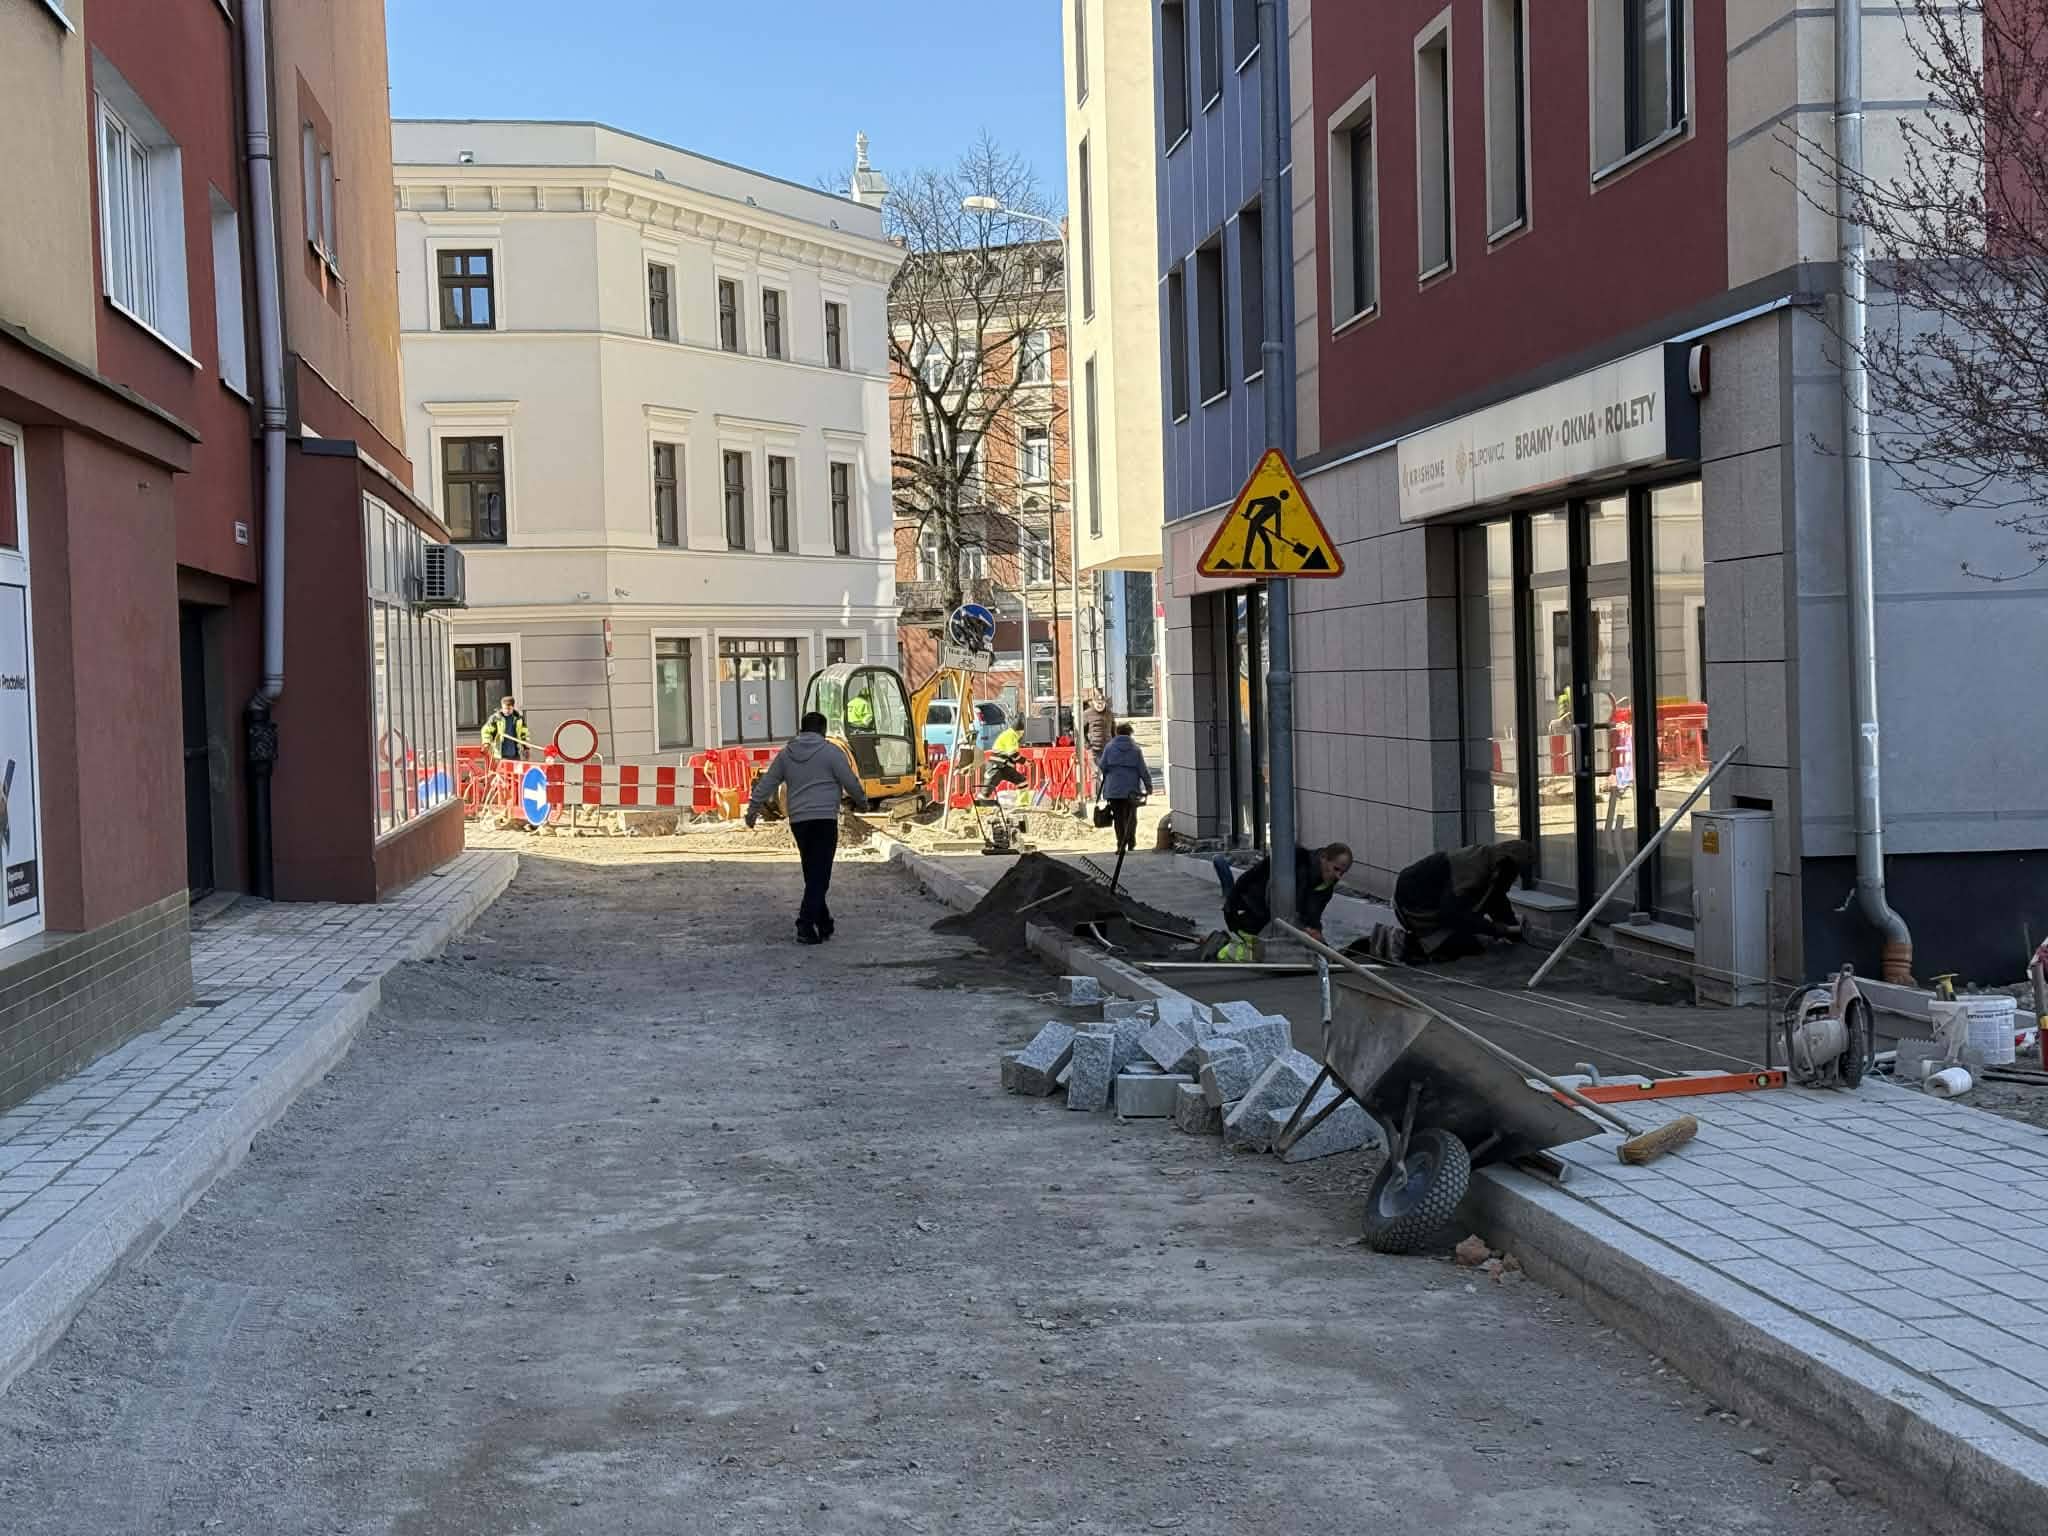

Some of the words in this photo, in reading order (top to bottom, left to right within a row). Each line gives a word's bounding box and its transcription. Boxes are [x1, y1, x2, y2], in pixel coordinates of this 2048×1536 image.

[1514, 425, 1554, 461] BRAMY
[1561, 410, 1596, 447] OKNA
[1605, 392, 1657, 435] ROLETY
[1409, 458, 1445, 486] KRISHOME
